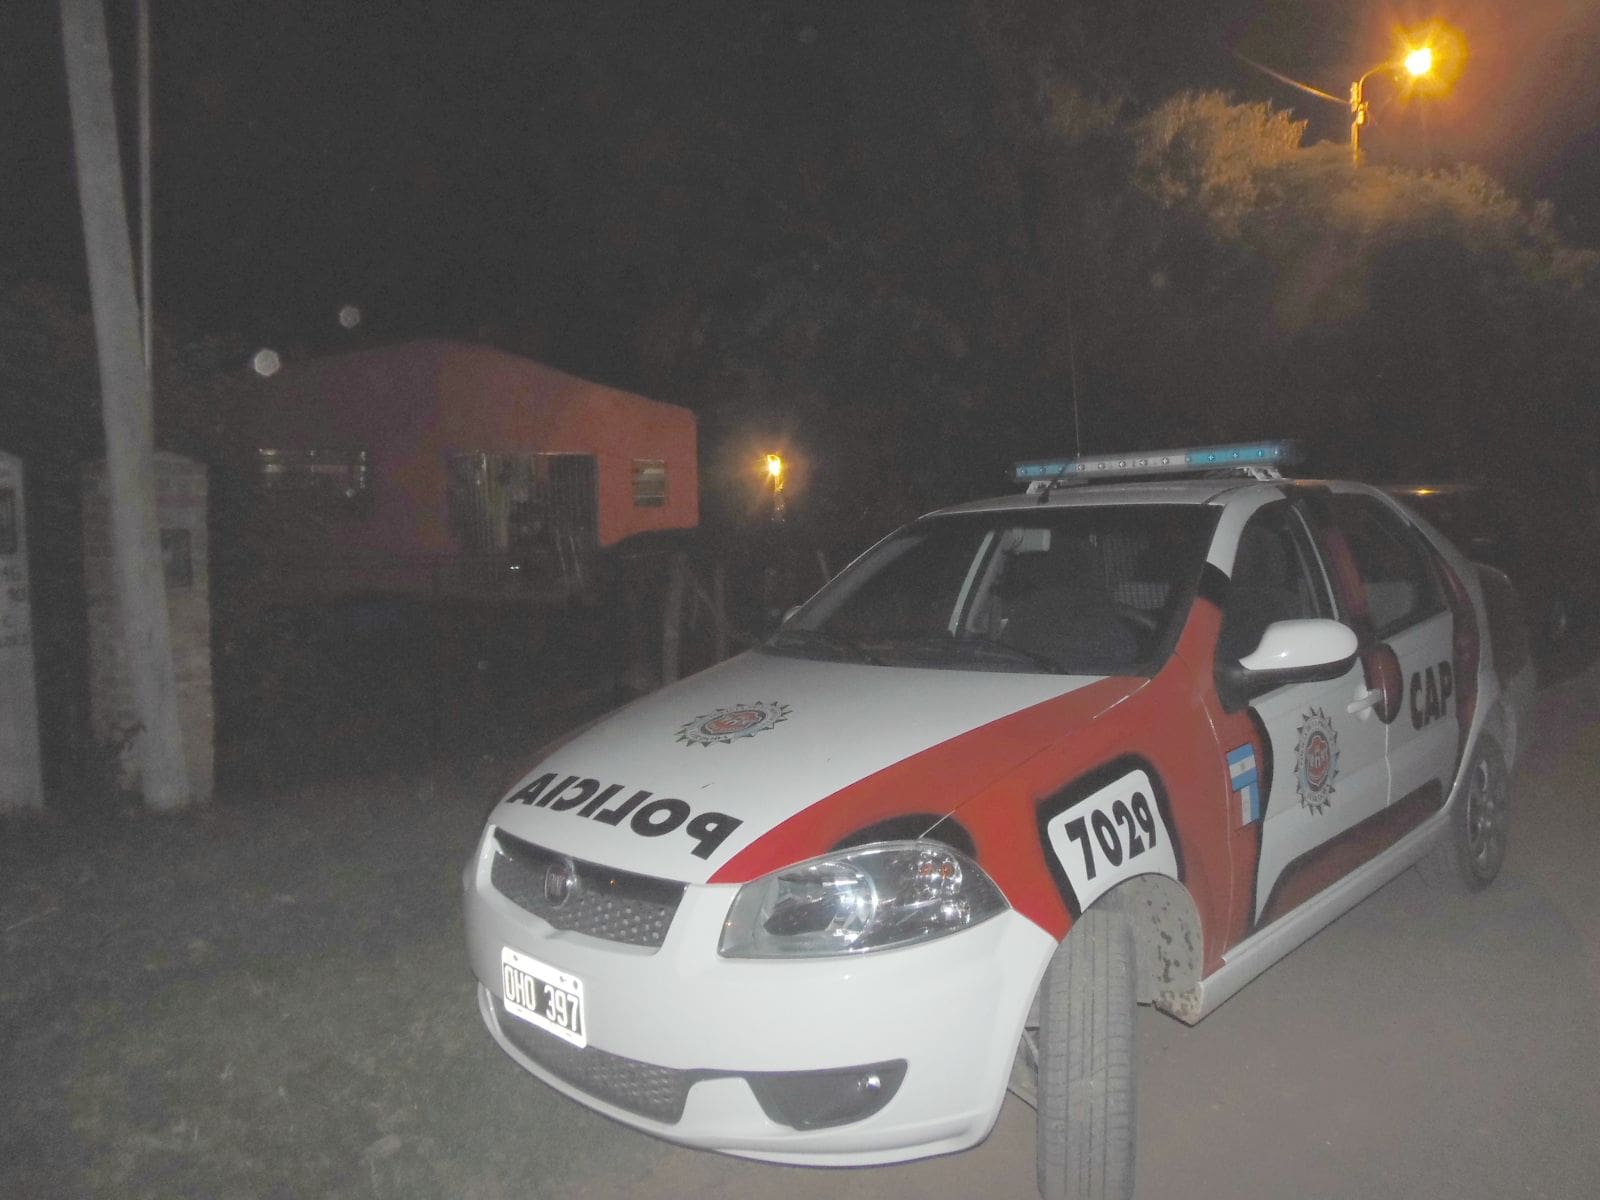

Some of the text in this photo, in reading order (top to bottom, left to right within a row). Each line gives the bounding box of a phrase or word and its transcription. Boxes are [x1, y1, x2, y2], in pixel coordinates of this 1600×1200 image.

[1410, 660, 1451, 730] CAP
[1064, 791, 1156, 880] 7029
[543, 984, 579, 1032] 397
